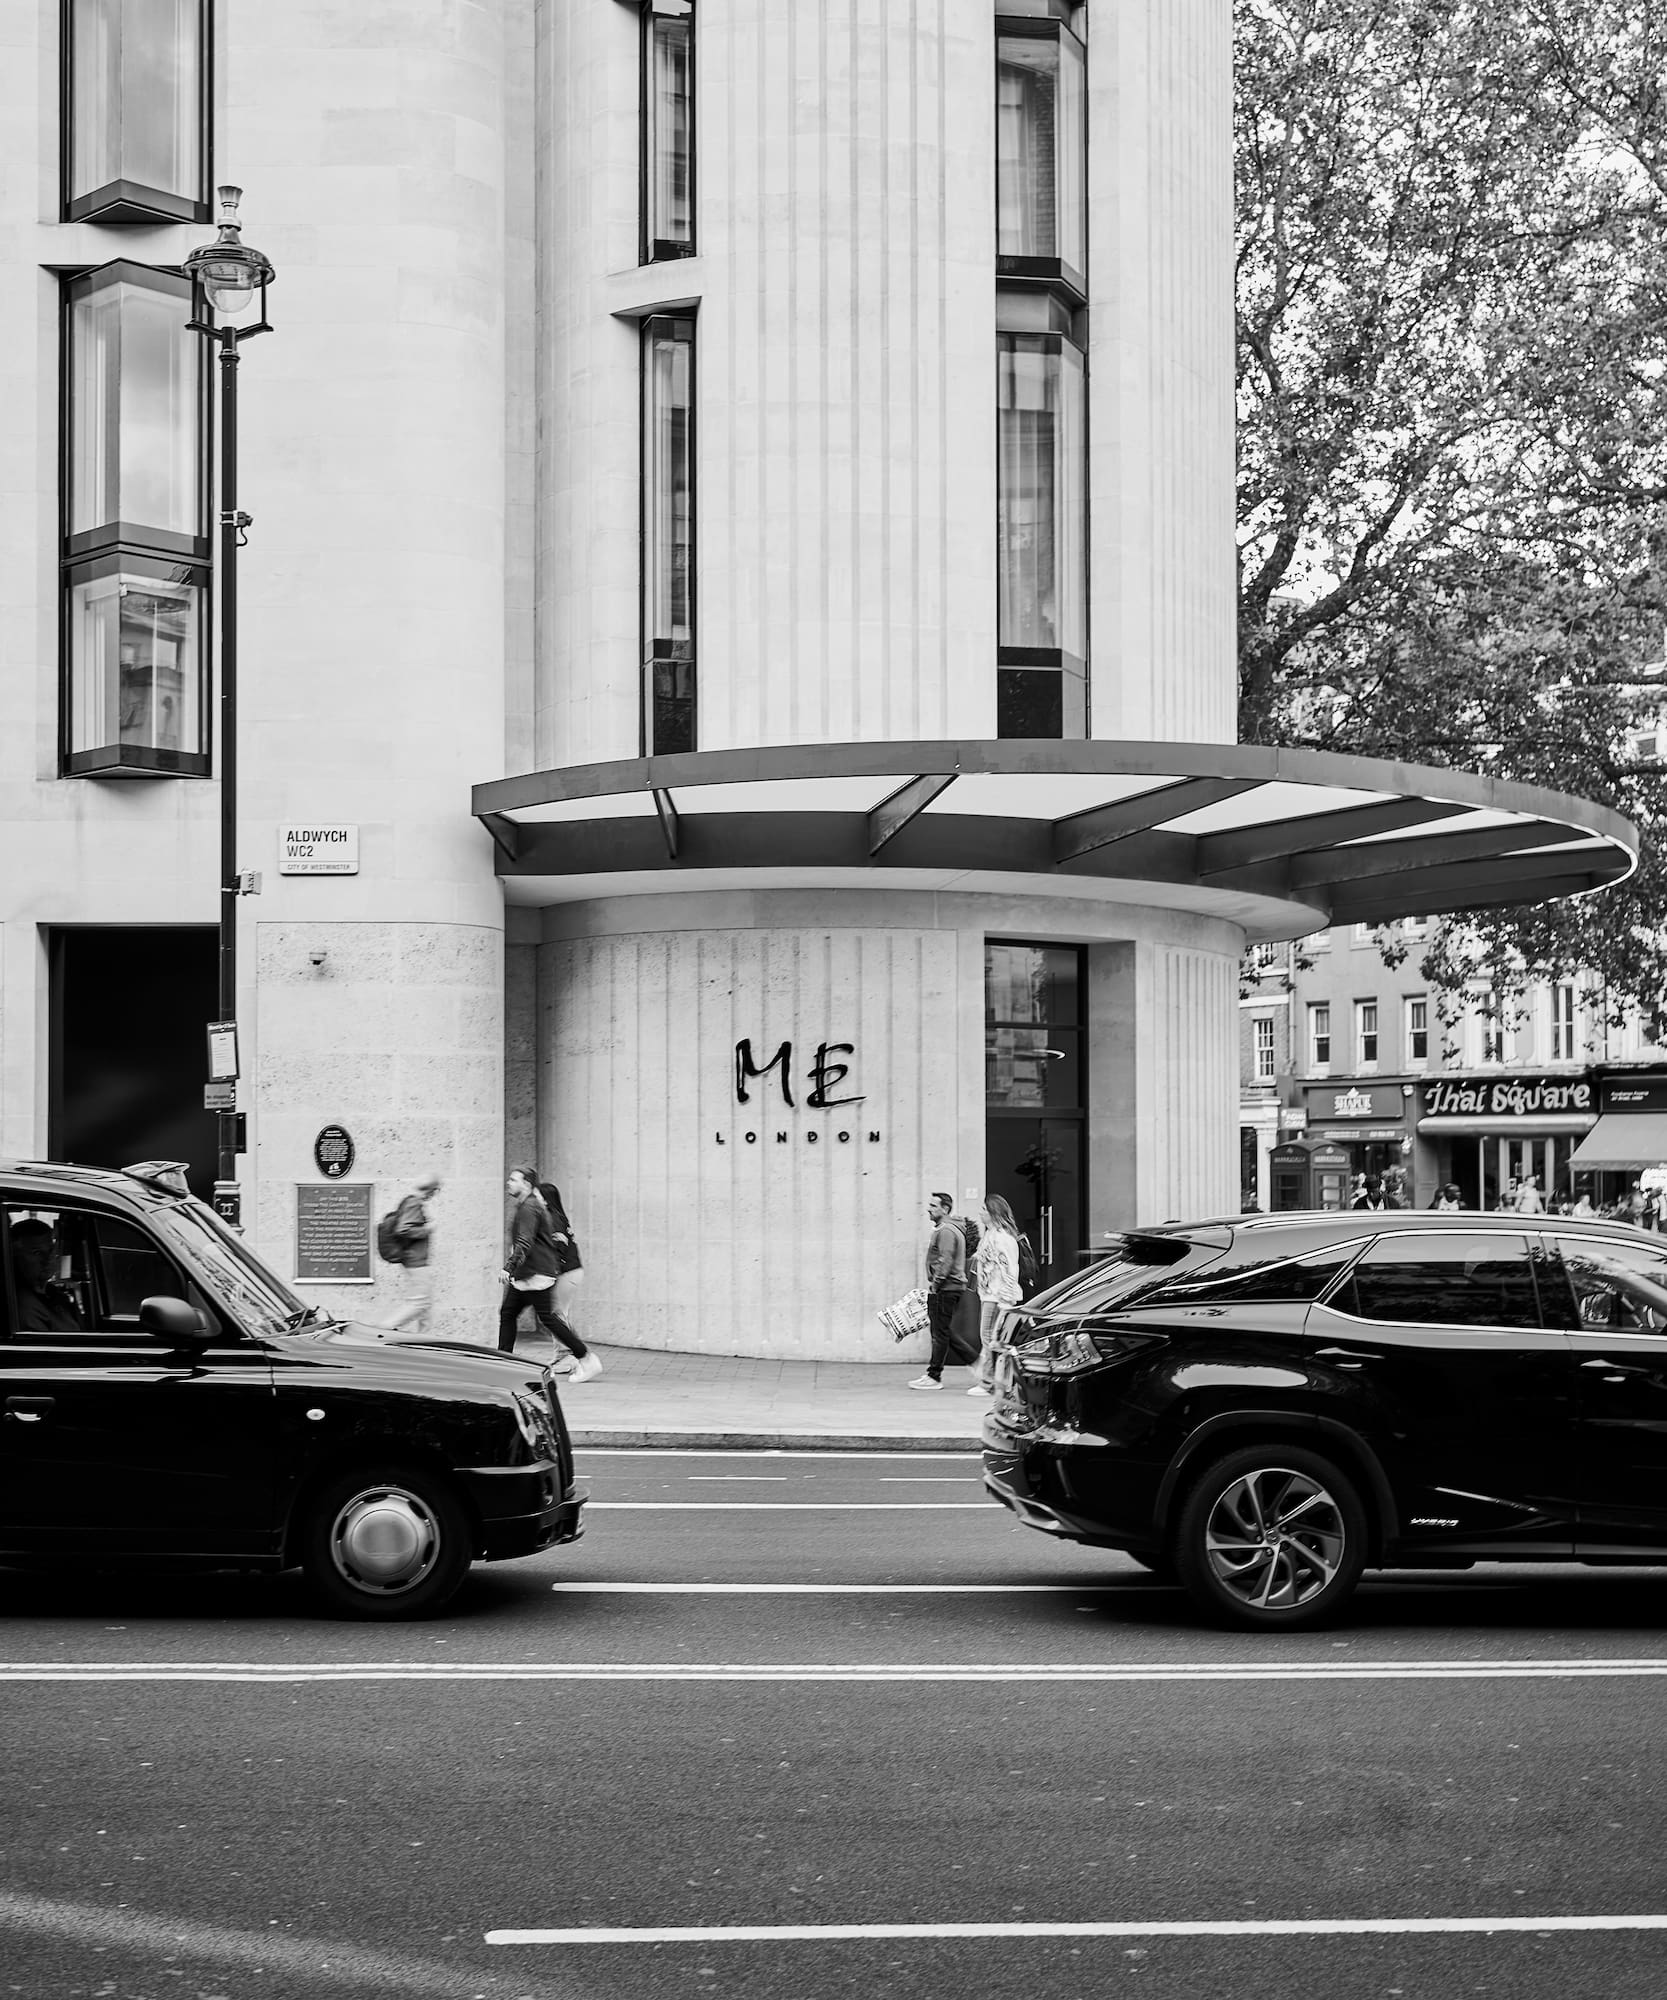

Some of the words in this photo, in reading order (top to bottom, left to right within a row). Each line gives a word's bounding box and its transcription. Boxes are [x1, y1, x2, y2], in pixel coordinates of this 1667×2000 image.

[287, 830, 347, 842] ALDWYCH
[287, 845, 313, 857] WC2
[736, 1038, 867, 1109] ME
[1425, 1081, 1487, 1115] Thai
[1491, 1078, 1591, 1115] Square
[715, 1131, 880, 1144] LONDON
